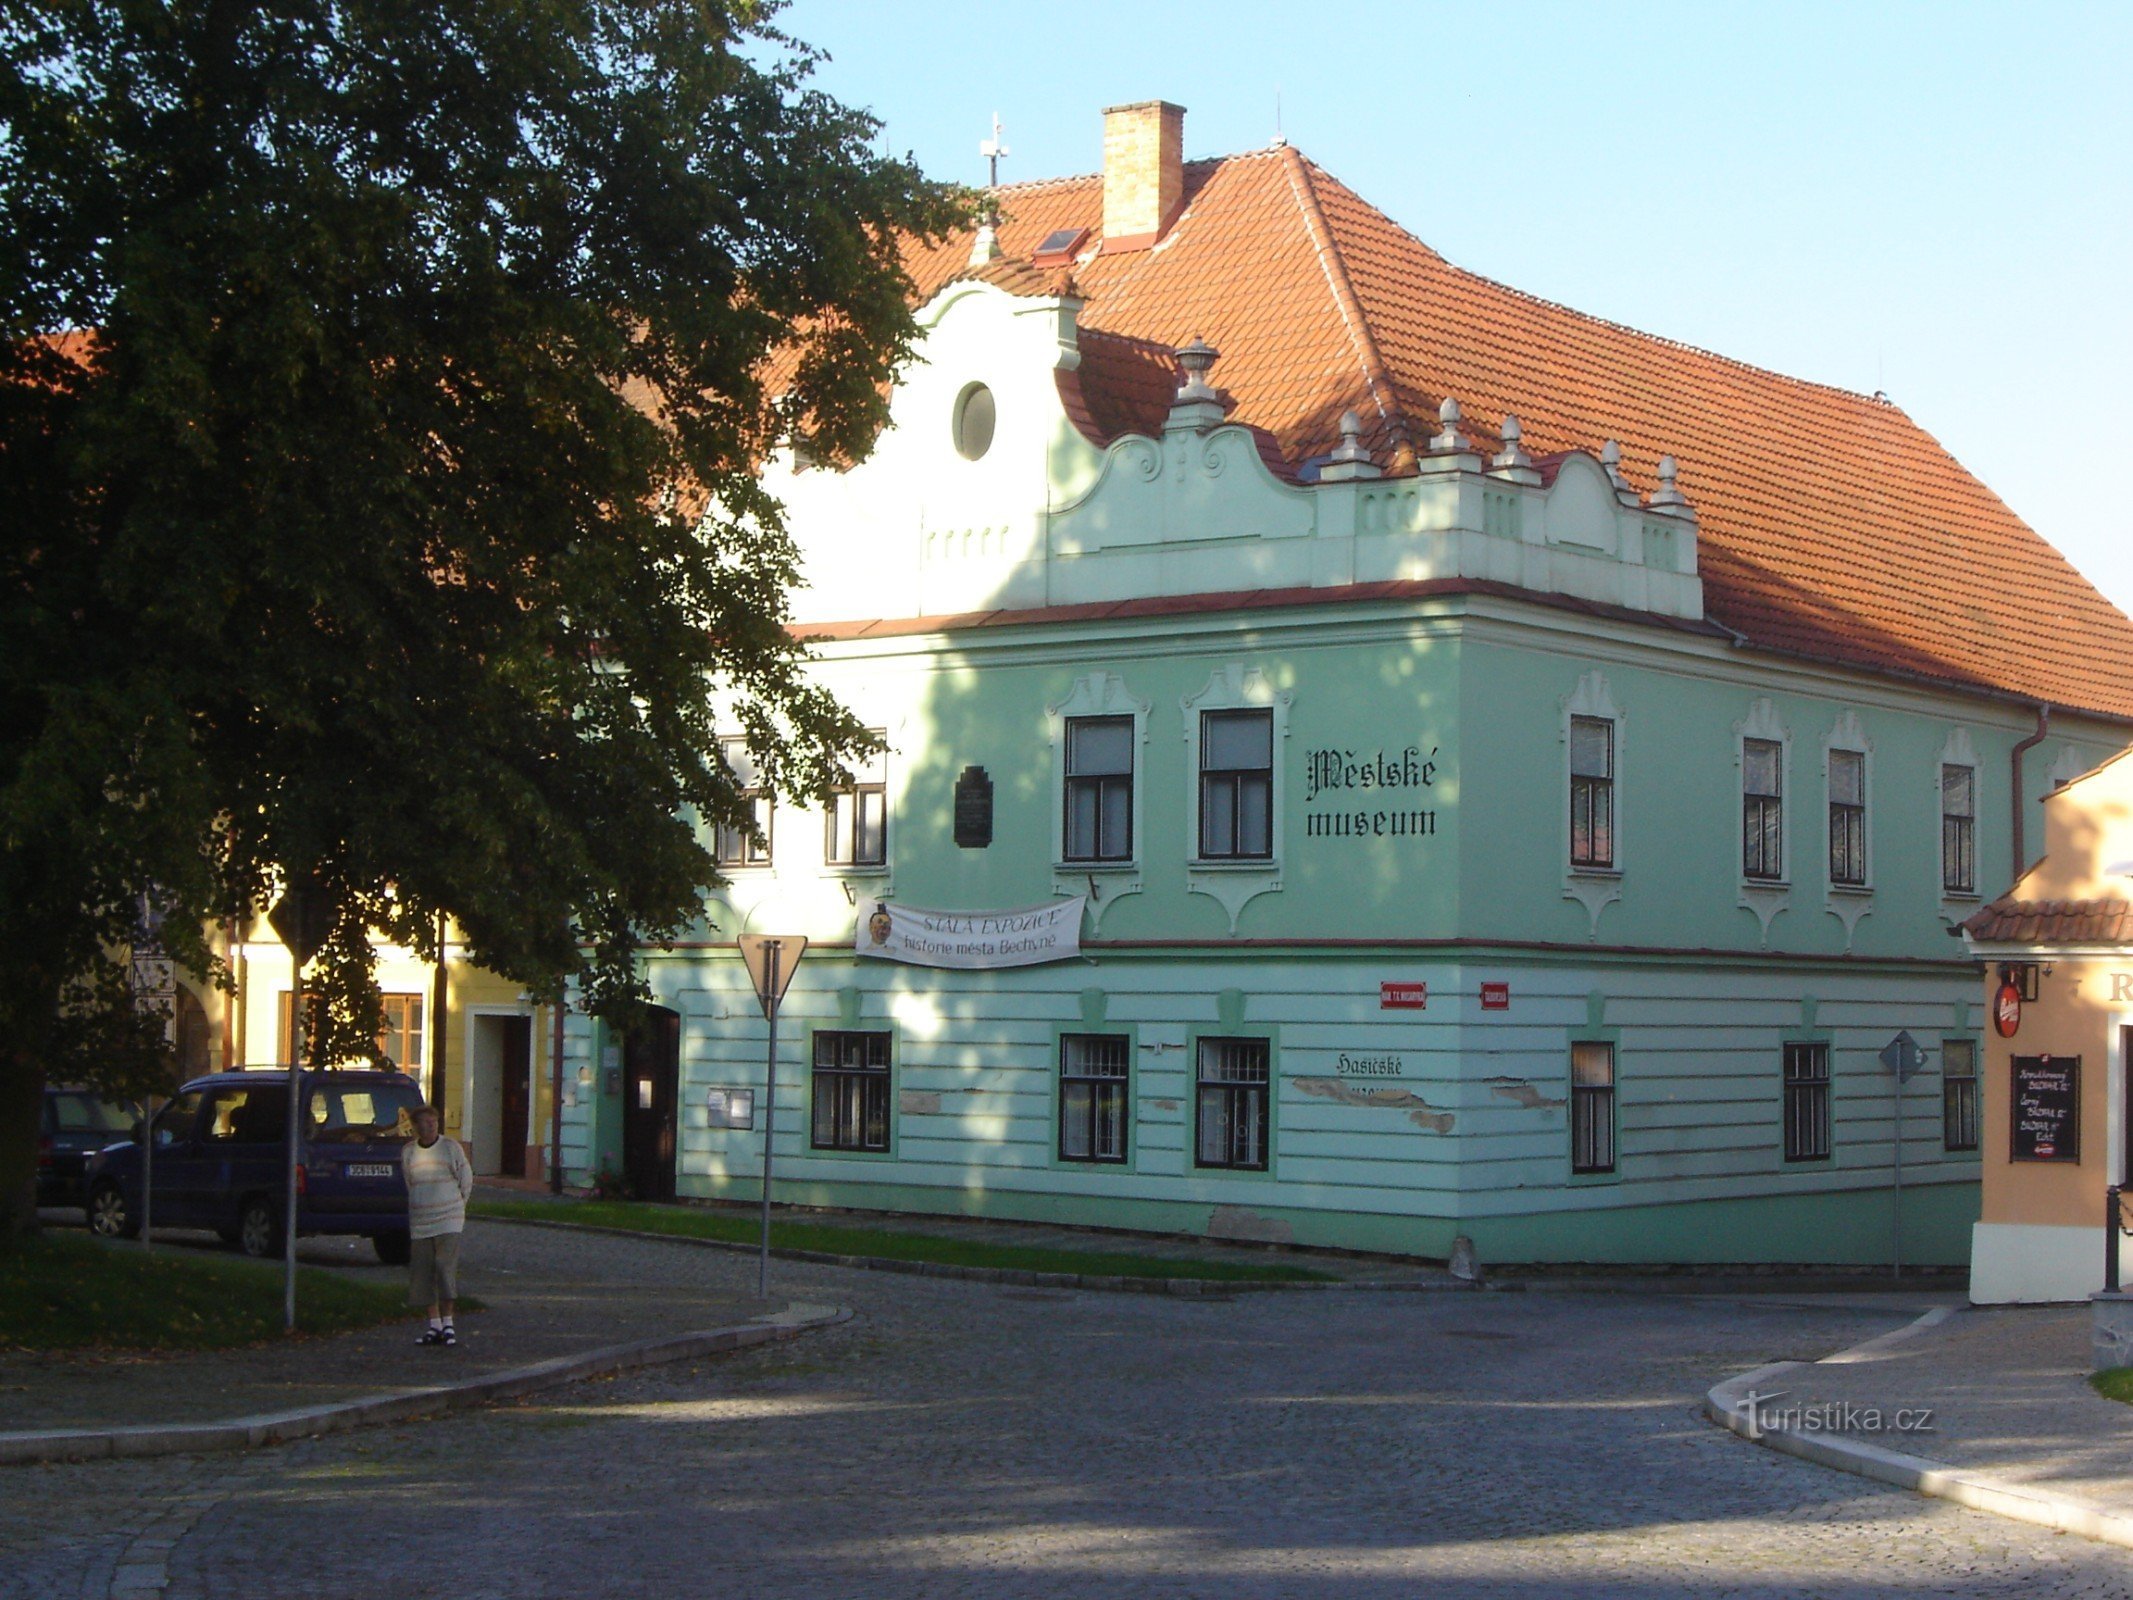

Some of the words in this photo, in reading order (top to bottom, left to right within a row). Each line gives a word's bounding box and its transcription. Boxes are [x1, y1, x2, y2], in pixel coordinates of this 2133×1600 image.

[1306, 747, 1438, 801] Městské
[1307, 811, 1436, 836] museum
[924, 914, 974, 935] STÁLÁ
[981, 908, 1062, 935] EXPOZICE
[904, 934, 951, 954] historie
[956, 940, 994, 956] města
[1000, 934, 1056, 955] Bechyně
